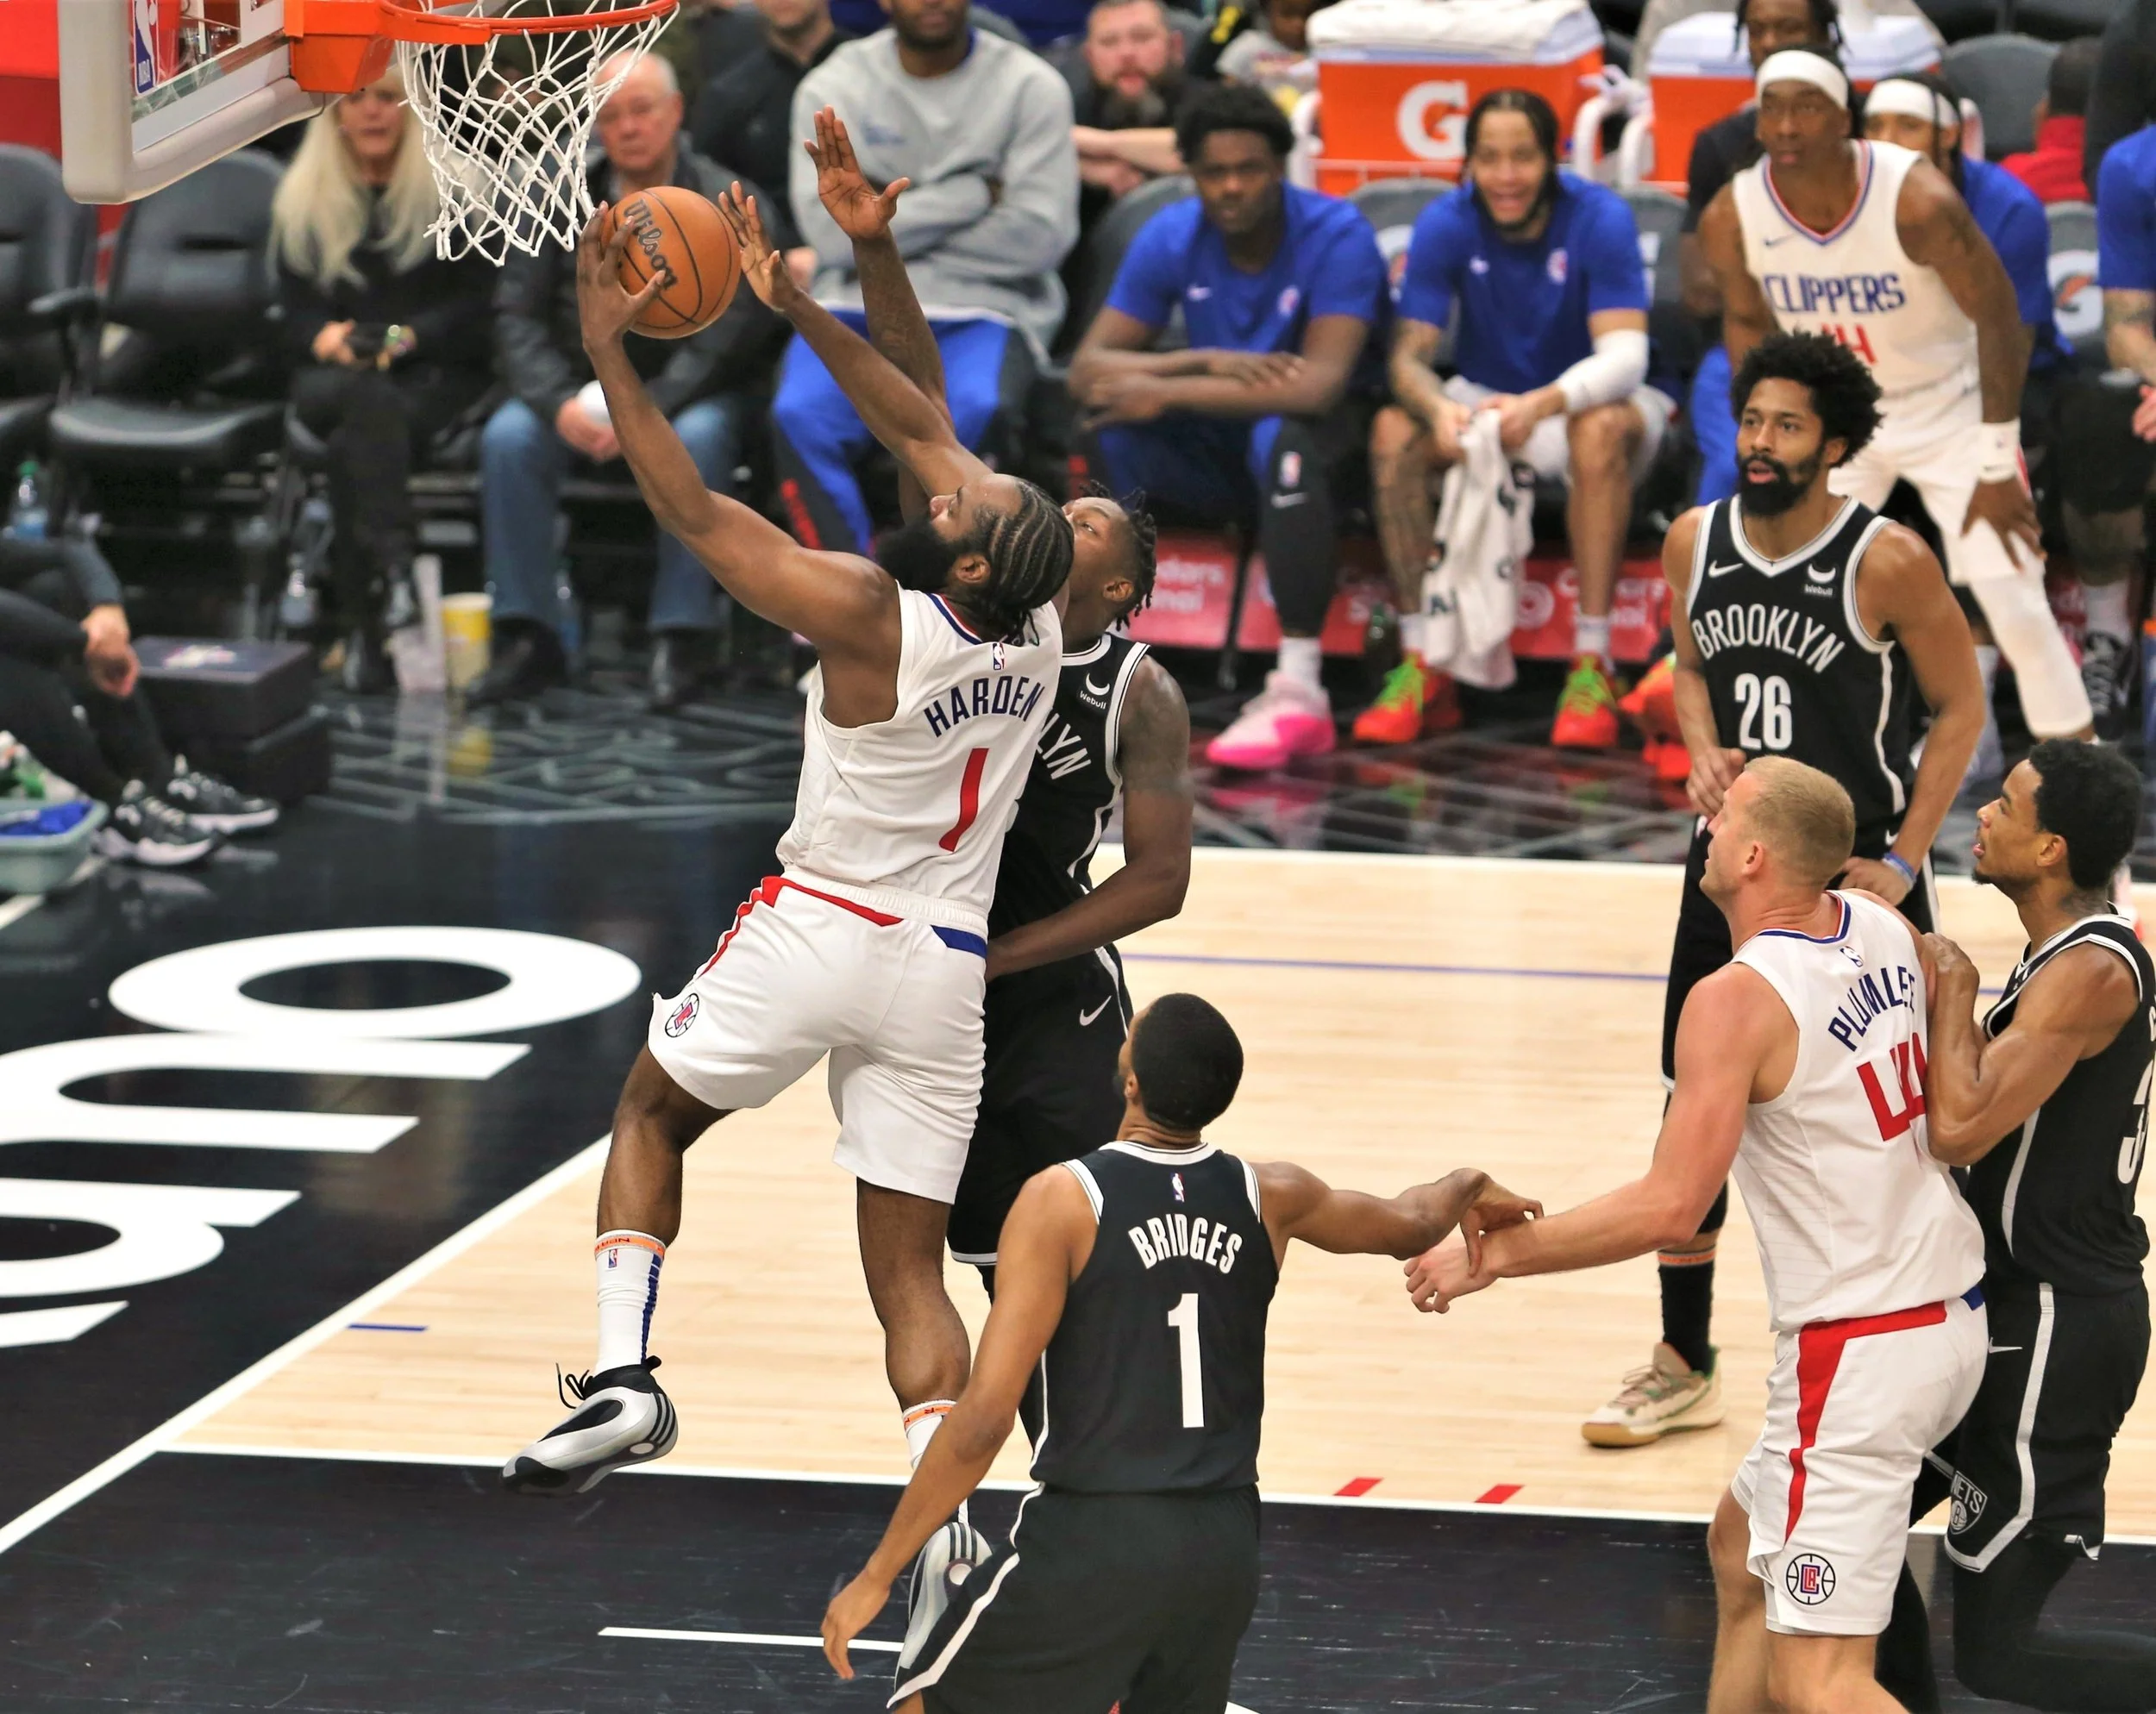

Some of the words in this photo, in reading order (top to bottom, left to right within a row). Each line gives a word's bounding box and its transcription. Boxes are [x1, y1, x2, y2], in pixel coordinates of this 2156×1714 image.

[1396, 79, 1467, 159] G
[624, 198, 677, 290] Wilson
[1764, 272, 1907, 316] CLIPPERS
[1821, 322, 1878, 365] 4
[1804, 584, 1833, 597] Webull
[1692, 604, 1846, 673] BROOKLYN
[924, 675, 1045, 737] HARDEN
[1080, 691, 1107, 710] Webull
[1734, 672, 1793, 751] 26
[938, 748, 989, 853] 1
[1128, 1213, 1243, 1274] BRIDGES
[1168, 1293, 1205, 1428] 1
